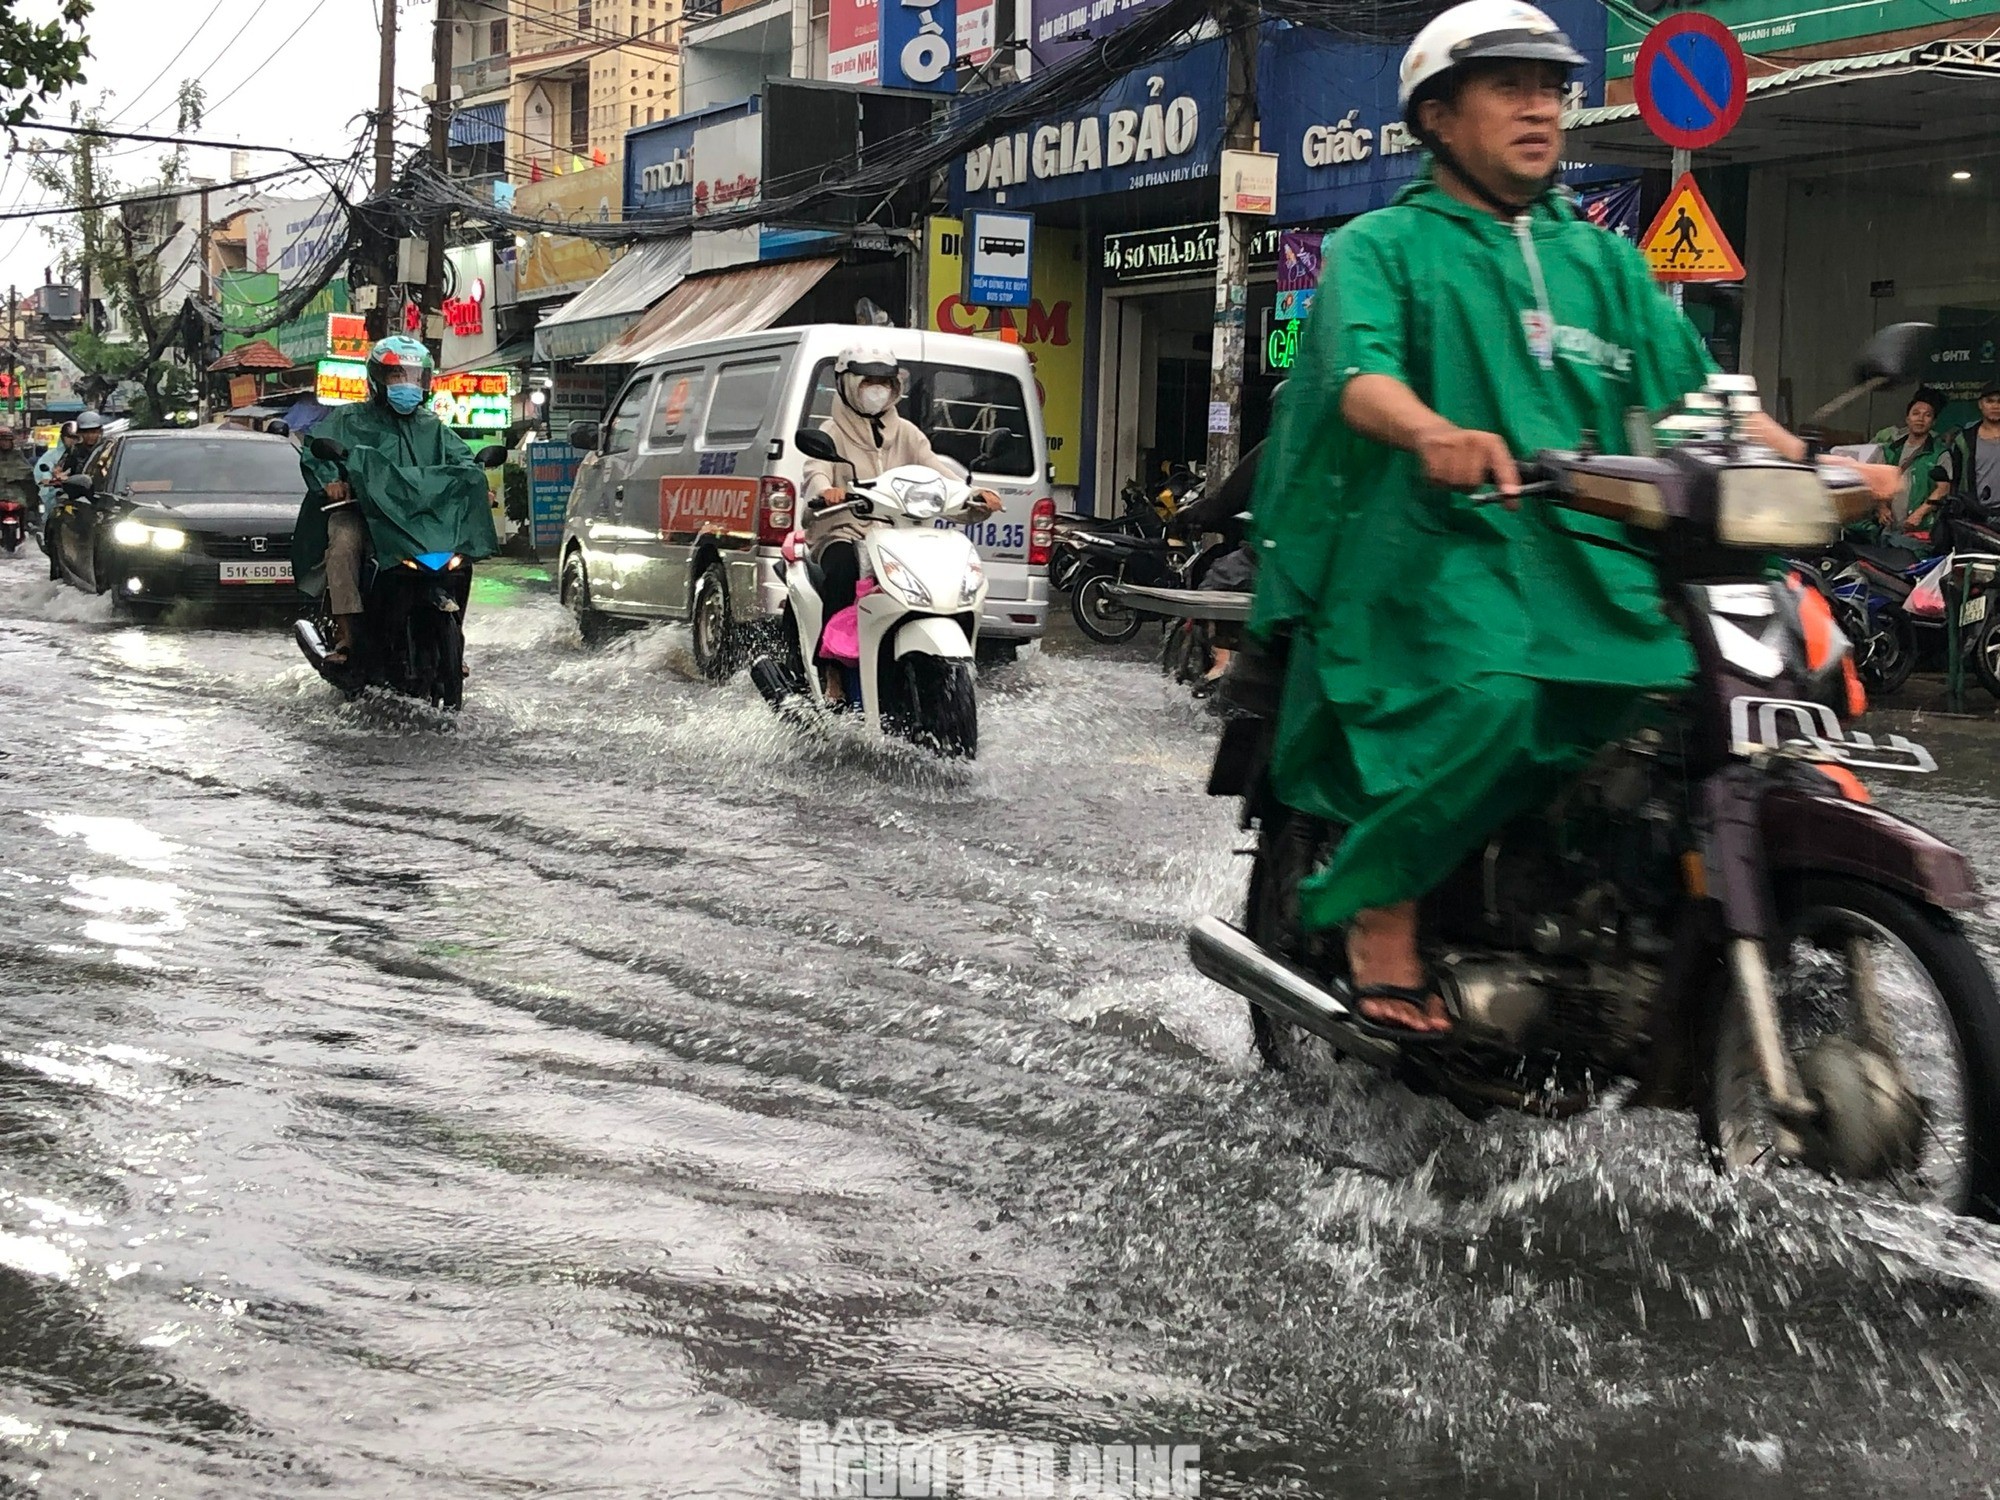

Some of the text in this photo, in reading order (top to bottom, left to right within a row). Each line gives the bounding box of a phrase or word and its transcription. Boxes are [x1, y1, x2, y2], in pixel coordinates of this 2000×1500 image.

[1738, 28, 1770, 43] NHANH
[1771, 20, 1797, 37] NHẤT
[857, 44, 877, 75] NHẬ
[965, 76, 1198, 204] ĐẠI GIA BẢO
[1302, 109, 1374, 167] Giấc
[1129, 162, 1209, 190] 248 PHAN HUY ÍCH
[681, 489, 750, 519] LALAMOVE
